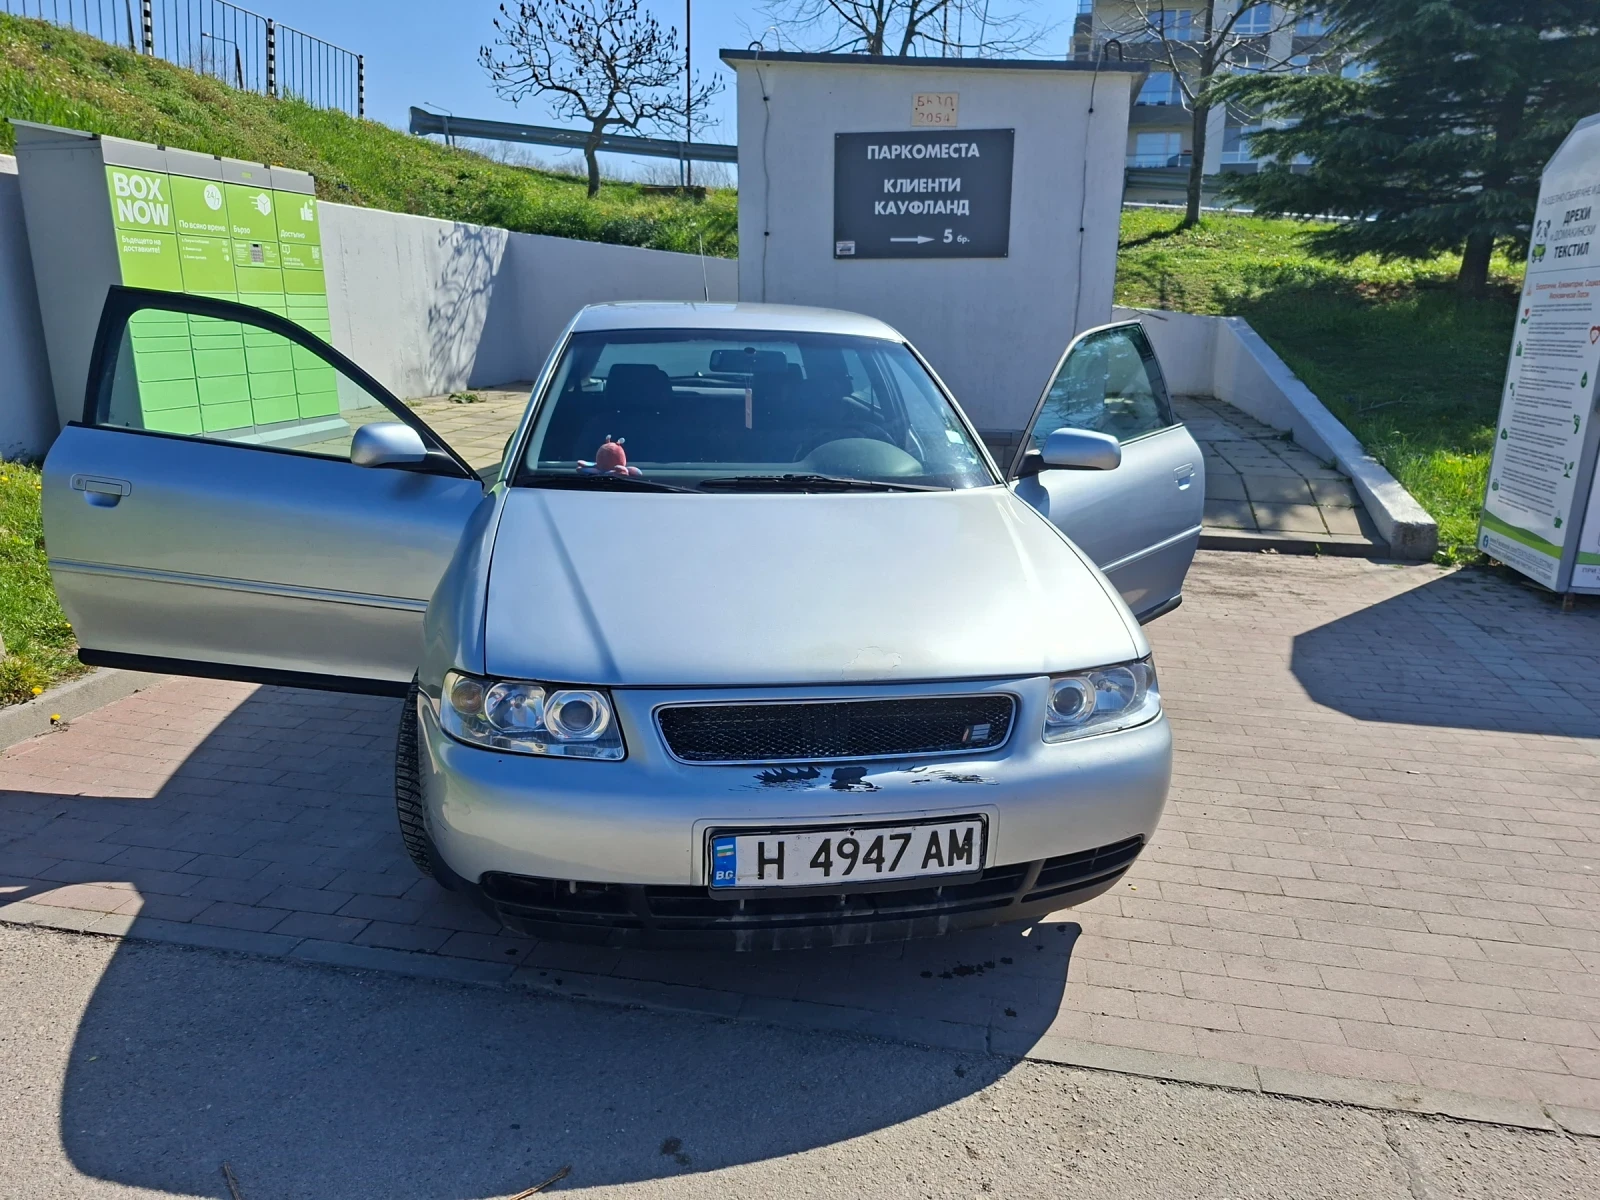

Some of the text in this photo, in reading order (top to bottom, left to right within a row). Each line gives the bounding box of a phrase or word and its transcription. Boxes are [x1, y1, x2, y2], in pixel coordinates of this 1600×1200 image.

[867, 143, 980, 160] ПАРКОМЕСТА
[113, 172, 164, 202] BOX
[883, 178, 961, 193] КЛИЕНТИ
[206, 189, 220, 206] 24/7
[117, 198, 169, 227] NOW
[874, 199, 970, 216] КАУФЛАНД
[1563, 206, 1592, 226] ДРЕХИ
[179, 219, 226, 233] По всяко време
[233, 225, 250, 235] Бързо
[280, 229, 306, 239] Достъпно
[121, 235, 153, 247] Бъдещето
[943, 229, 970, 245] 5 бр.
[123, 246, 161, 254] доставките!
[1554, 242, 1590, 259] ТЕКСТИЛ
[757, 827, 974, 880] H 4947 AM
[716, 870, 735, 881] BG
